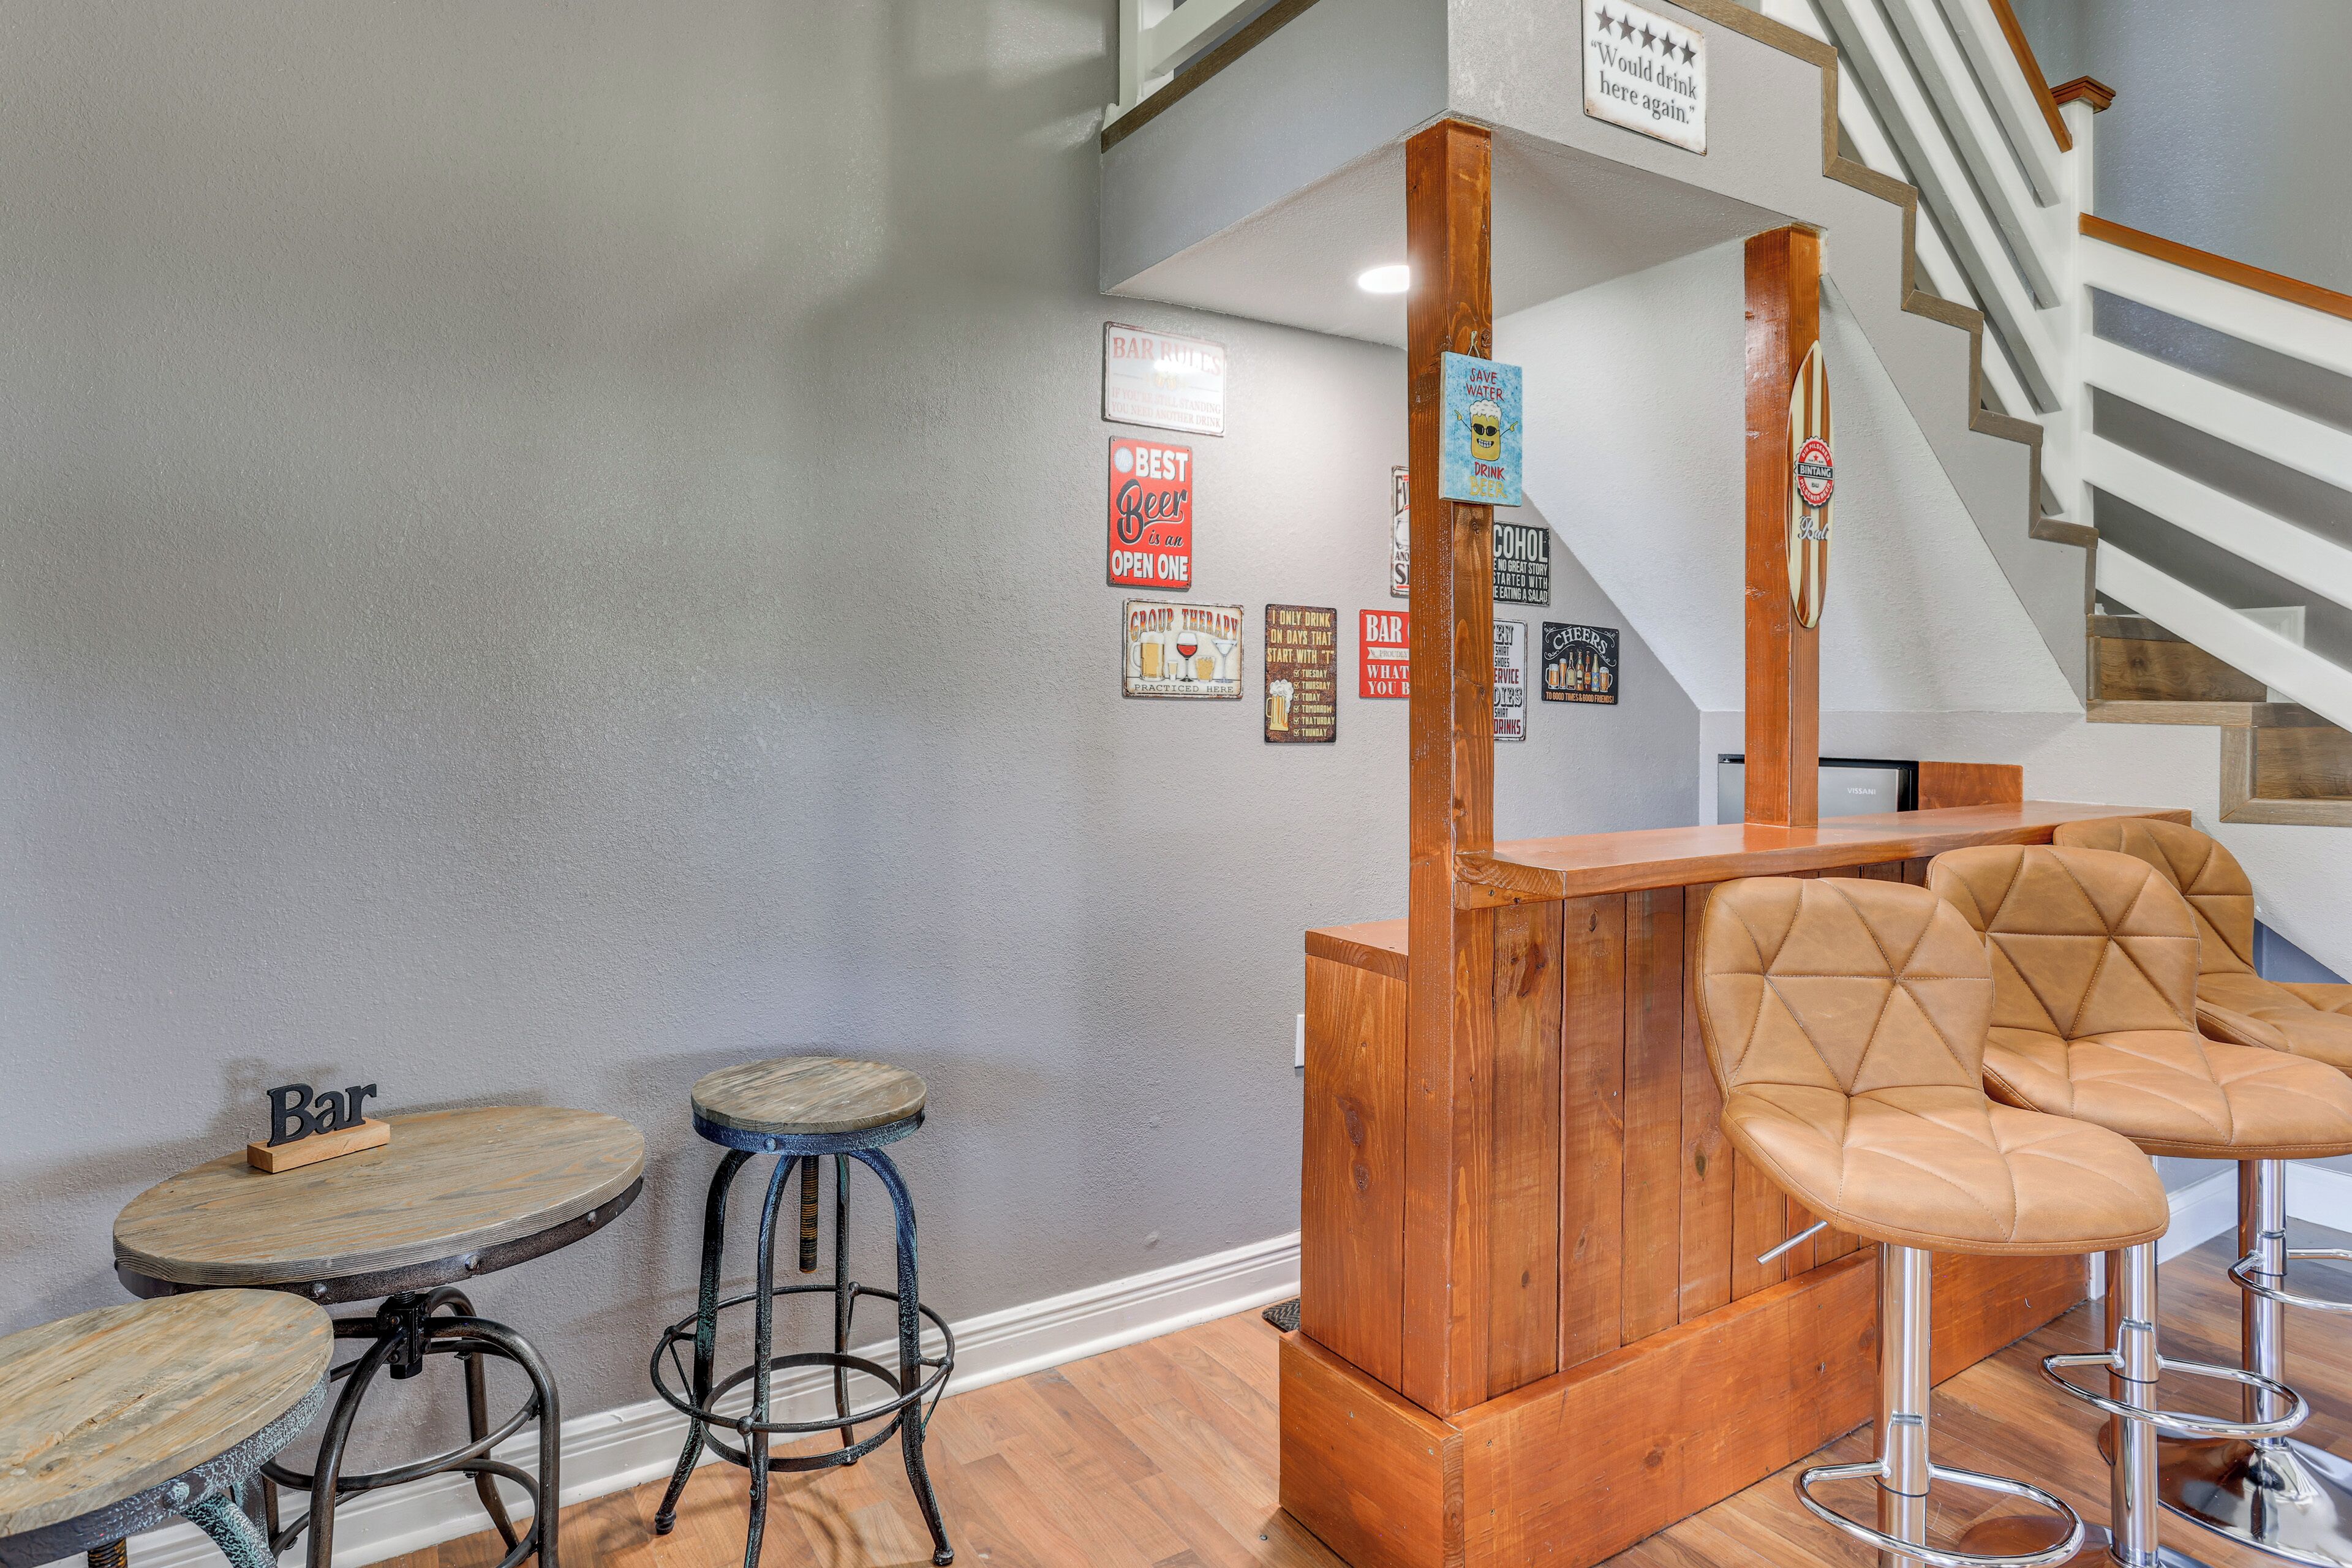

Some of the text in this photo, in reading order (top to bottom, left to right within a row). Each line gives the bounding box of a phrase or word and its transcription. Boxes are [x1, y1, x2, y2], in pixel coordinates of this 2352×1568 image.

[1600, 70, 1638, 105] here
[1657, 66, 1697, 100] drink
[1113, 337, 1155, 360] BAR
[1470, 368, 1498, 385] SAVE
[1112, 386, 1120, 398] IF
[1179, 397, 1221, 415] STANDING
[1466, 382, 1505, 402] WATER
[1112, 401, 1221, 429] YOU NEED ANOTHER DRINK
[1136, 447, 1189, 482] BEST
[1475, 462, 1506, 481] DRINK
[1800, 464, 1831, 478] BINTANG
[1470, 476, 1507, 499] BEER
[1116, 478, 1188, 545] Beer
[1149, 530, 1184, 548] is an
[1493, 524, 1548, 563] COHOL
[1111, 549, 1189, 582] OPEN ONE
[1395, 551, 1410, 562] ANO
[1498, 559, 1507, 571] NO
[1508, 559, 1527, 574] GREAT
[1528, 562, 1548, 576] STORY
[1529, 575, 1548, 589] WITH
[1499, 586, 1521, 600] EATING
[1522, 588, 1527, 601] A
[1528, 589, 1548, 603] SALAD
[1130, 608, 1238, 642] GROUP THERAPY
[1272, 610, 1331, 628] I ONLY DRINK
[1271, 628, 1332, 646] ON DAYS THAT
[1366, 614, 1403, 643] BAR
[1493, 624, 1514, 646] EN
[1553, 626, 1608, 654] CHEERS
[1267, 647, 1293, 663] START
[1297, 649, 1317, 665] WITH
[1379, 650, 1408, 658] PROUDLY
[1495, 646, 1509, 656] SHIRT
[1494, 657, 1510, 668] SHOES
[1302, 669, 1327, 678] TUESDAY
[1366, 665, 1410, 679] WHAT
[1302, 681, 1330, 690] THURSDAY
[1368, 680, 1396, 695] YOU
[1302, 693, 1321, 701] TODAY
[1545, 692, 1552, 700] TO
[1553, 692, 1564, 701] GOOD
[1565, 692, 1579, 701] TIMES
[1583, 693, 1594, 702] GOOD
[1594, 694, 1614, 704] FRIENDS!
[1302, 704, 1332, 714] TOMORROW
[1494, 707, 1508, 718] SHIRT
[1302, 717, 1335, 725] THATURDAY
[1493, 718, 1521, 735] DRINKS
[1302, 728, 1327, 737] THUNDAY
[267, 1083, 377, 1147] Bar
